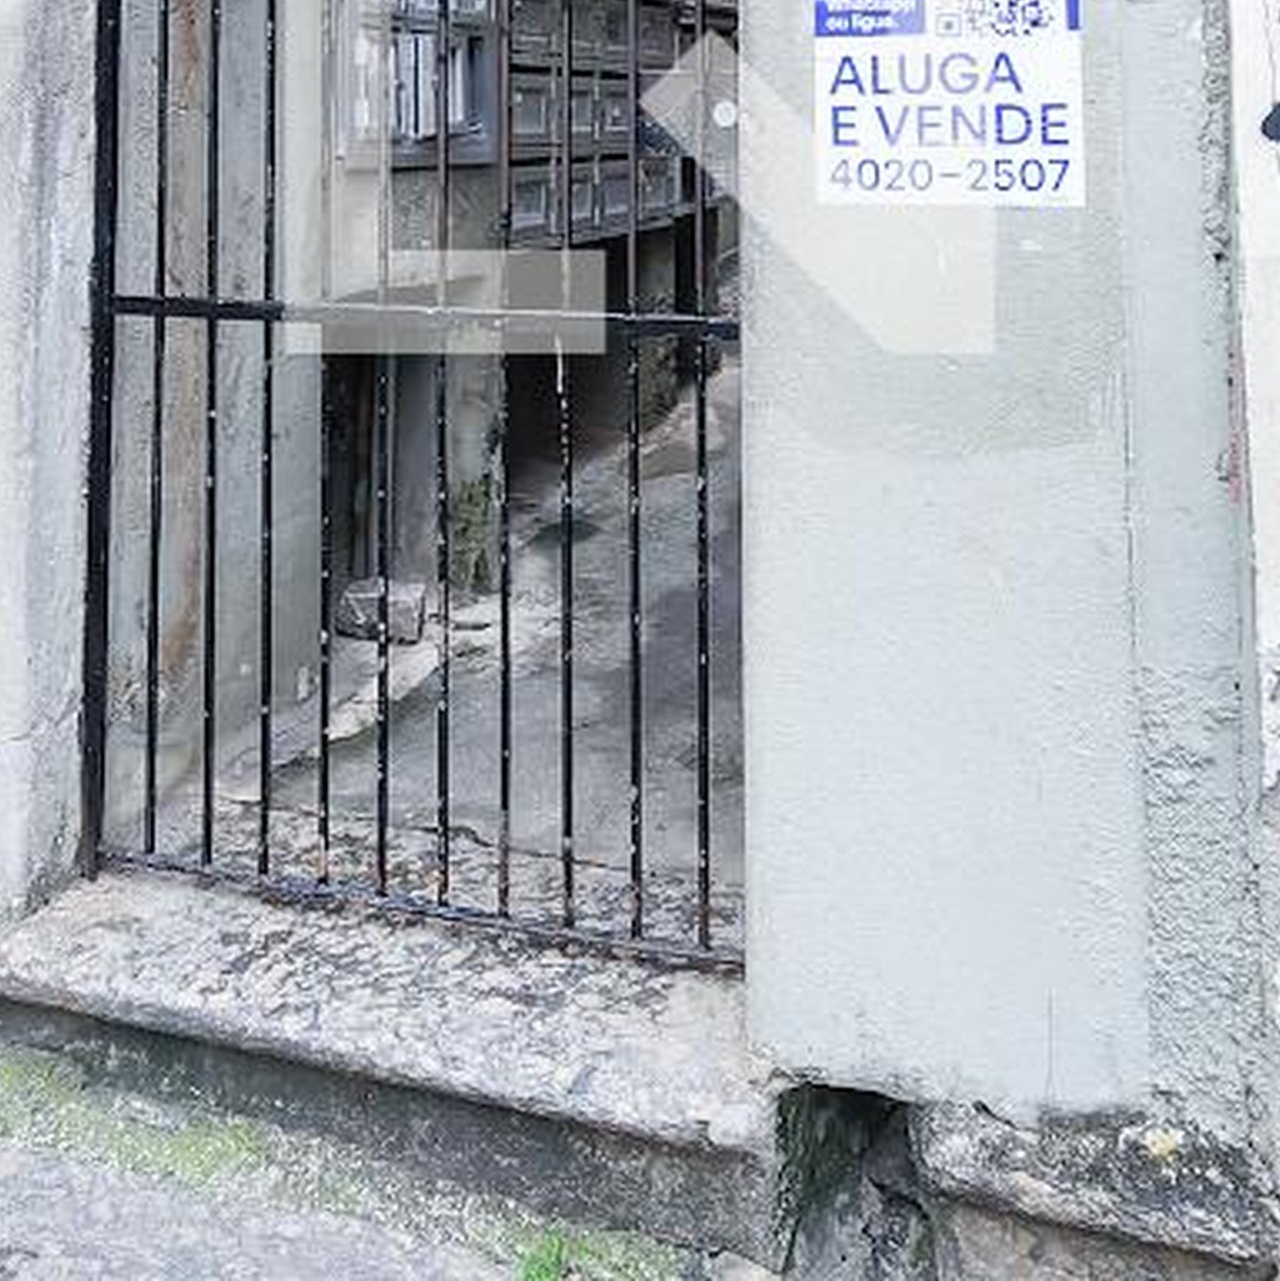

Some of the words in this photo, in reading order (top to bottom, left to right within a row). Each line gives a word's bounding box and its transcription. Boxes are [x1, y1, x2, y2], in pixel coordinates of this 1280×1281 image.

[829, 52, 1023, 96] ALUGA
[831, 105, 859, 147] E
[874, 102, 1070, 148] VENDE
[829, 157, 1071, 193] 4020-2507
